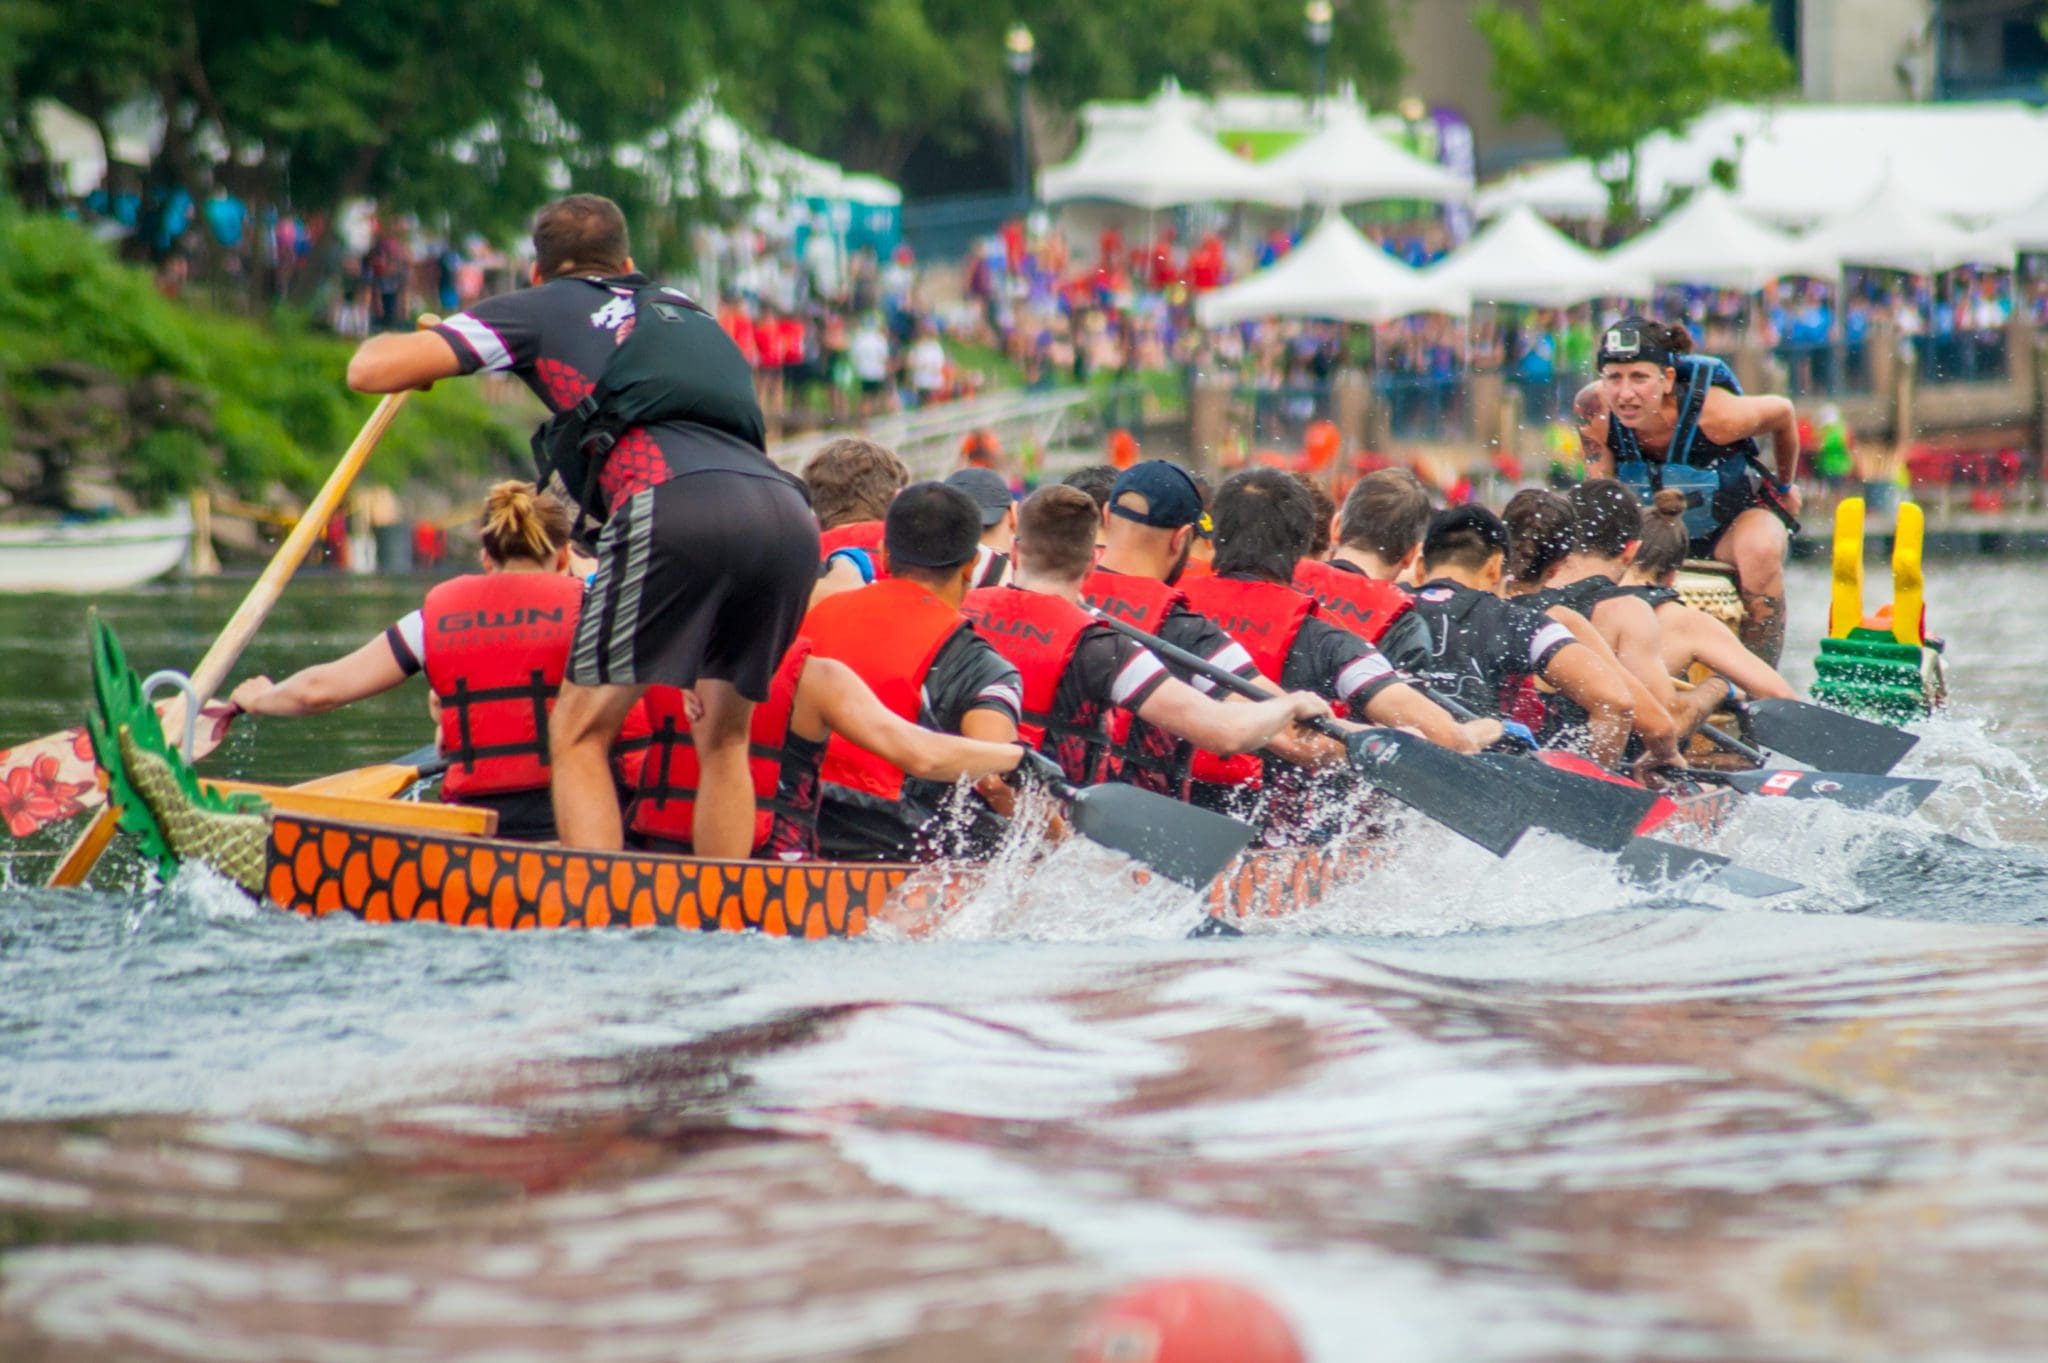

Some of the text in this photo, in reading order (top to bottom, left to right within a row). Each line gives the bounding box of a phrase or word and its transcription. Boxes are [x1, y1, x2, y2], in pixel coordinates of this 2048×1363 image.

[1086, 593, 1147, 620] WN
[437, 607, 564, 633] GWN
[1211, 615, 1272, 636] WN
